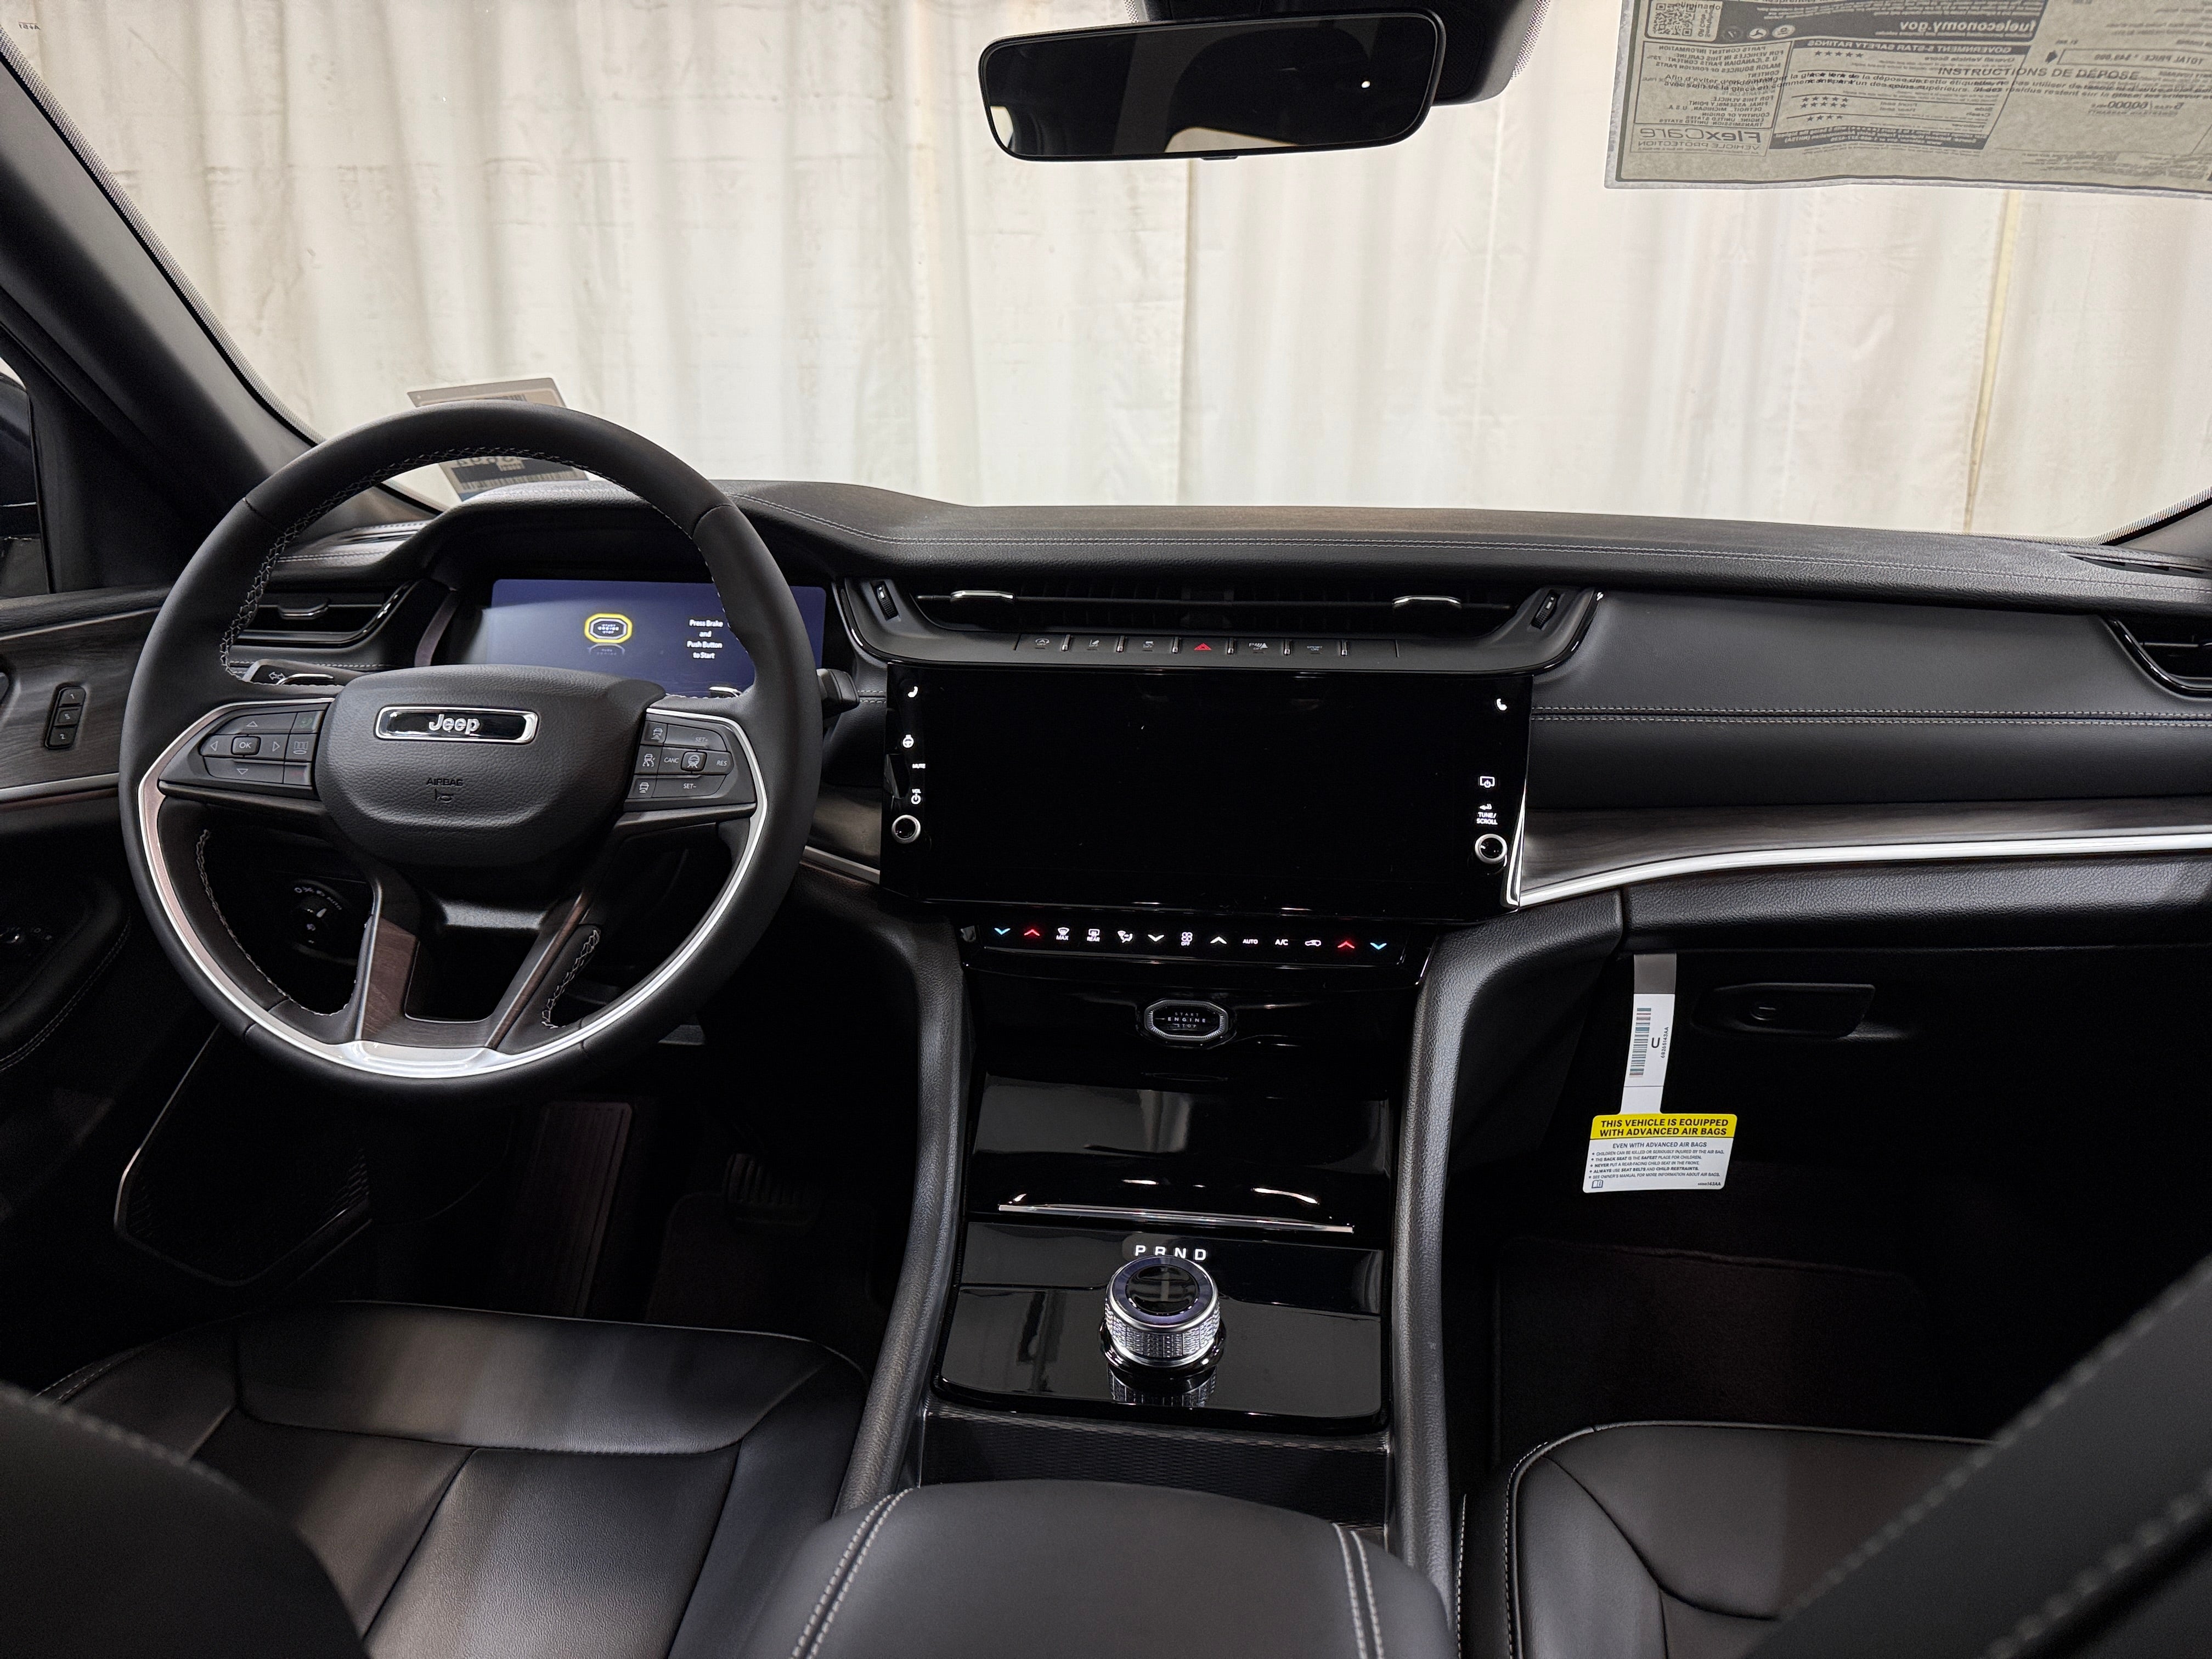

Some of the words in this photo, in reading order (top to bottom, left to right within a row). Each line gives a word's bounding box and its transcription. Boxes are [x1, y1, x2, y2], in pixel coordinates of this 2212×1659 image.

[1938, 67, 2047, 76] INSTRUCTIONS
[2051, 68, 2073, 77] DE
[429, 714, 480, 735] Jeep
[426, 778, 464, 786] AIRBAG
[1651, 1037, 1660, 1048] U
[1135, 1245, 1146, 1256] P
[1155, 1246, 1166, 1255] R
[1175, 1248, 1187, 1259] N
[1194, 1249, 1206, 1261] D
